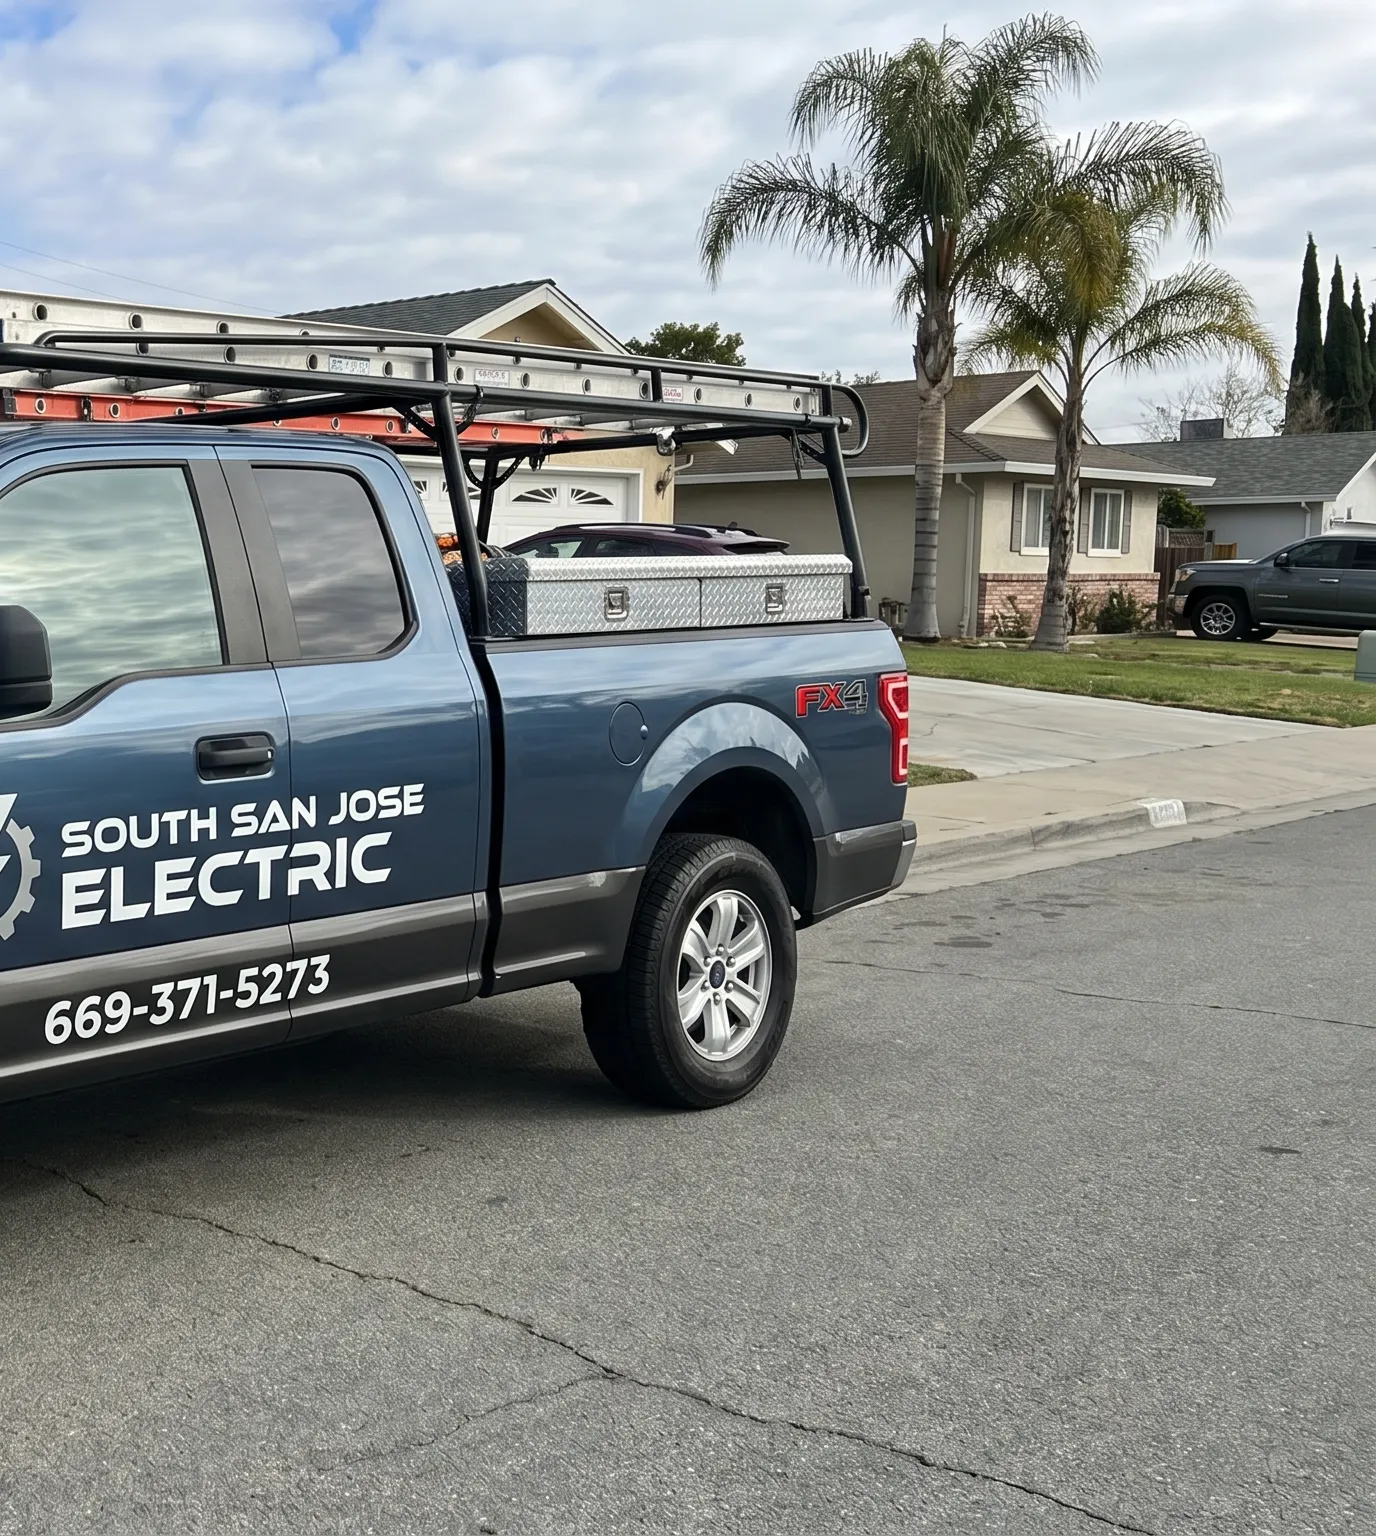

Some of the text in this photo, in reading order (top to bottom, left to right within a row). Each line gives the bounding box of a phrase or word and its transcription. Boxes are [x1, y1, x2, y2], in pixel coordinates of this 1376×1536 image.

[795, 679, 868, 718] FX4
[61, 783, 425, 858] SOUTH SAN JOSE
[61, 831, 393, 930] ELECTRIC
[44, 954, 331, 1045] 669-371-5273
